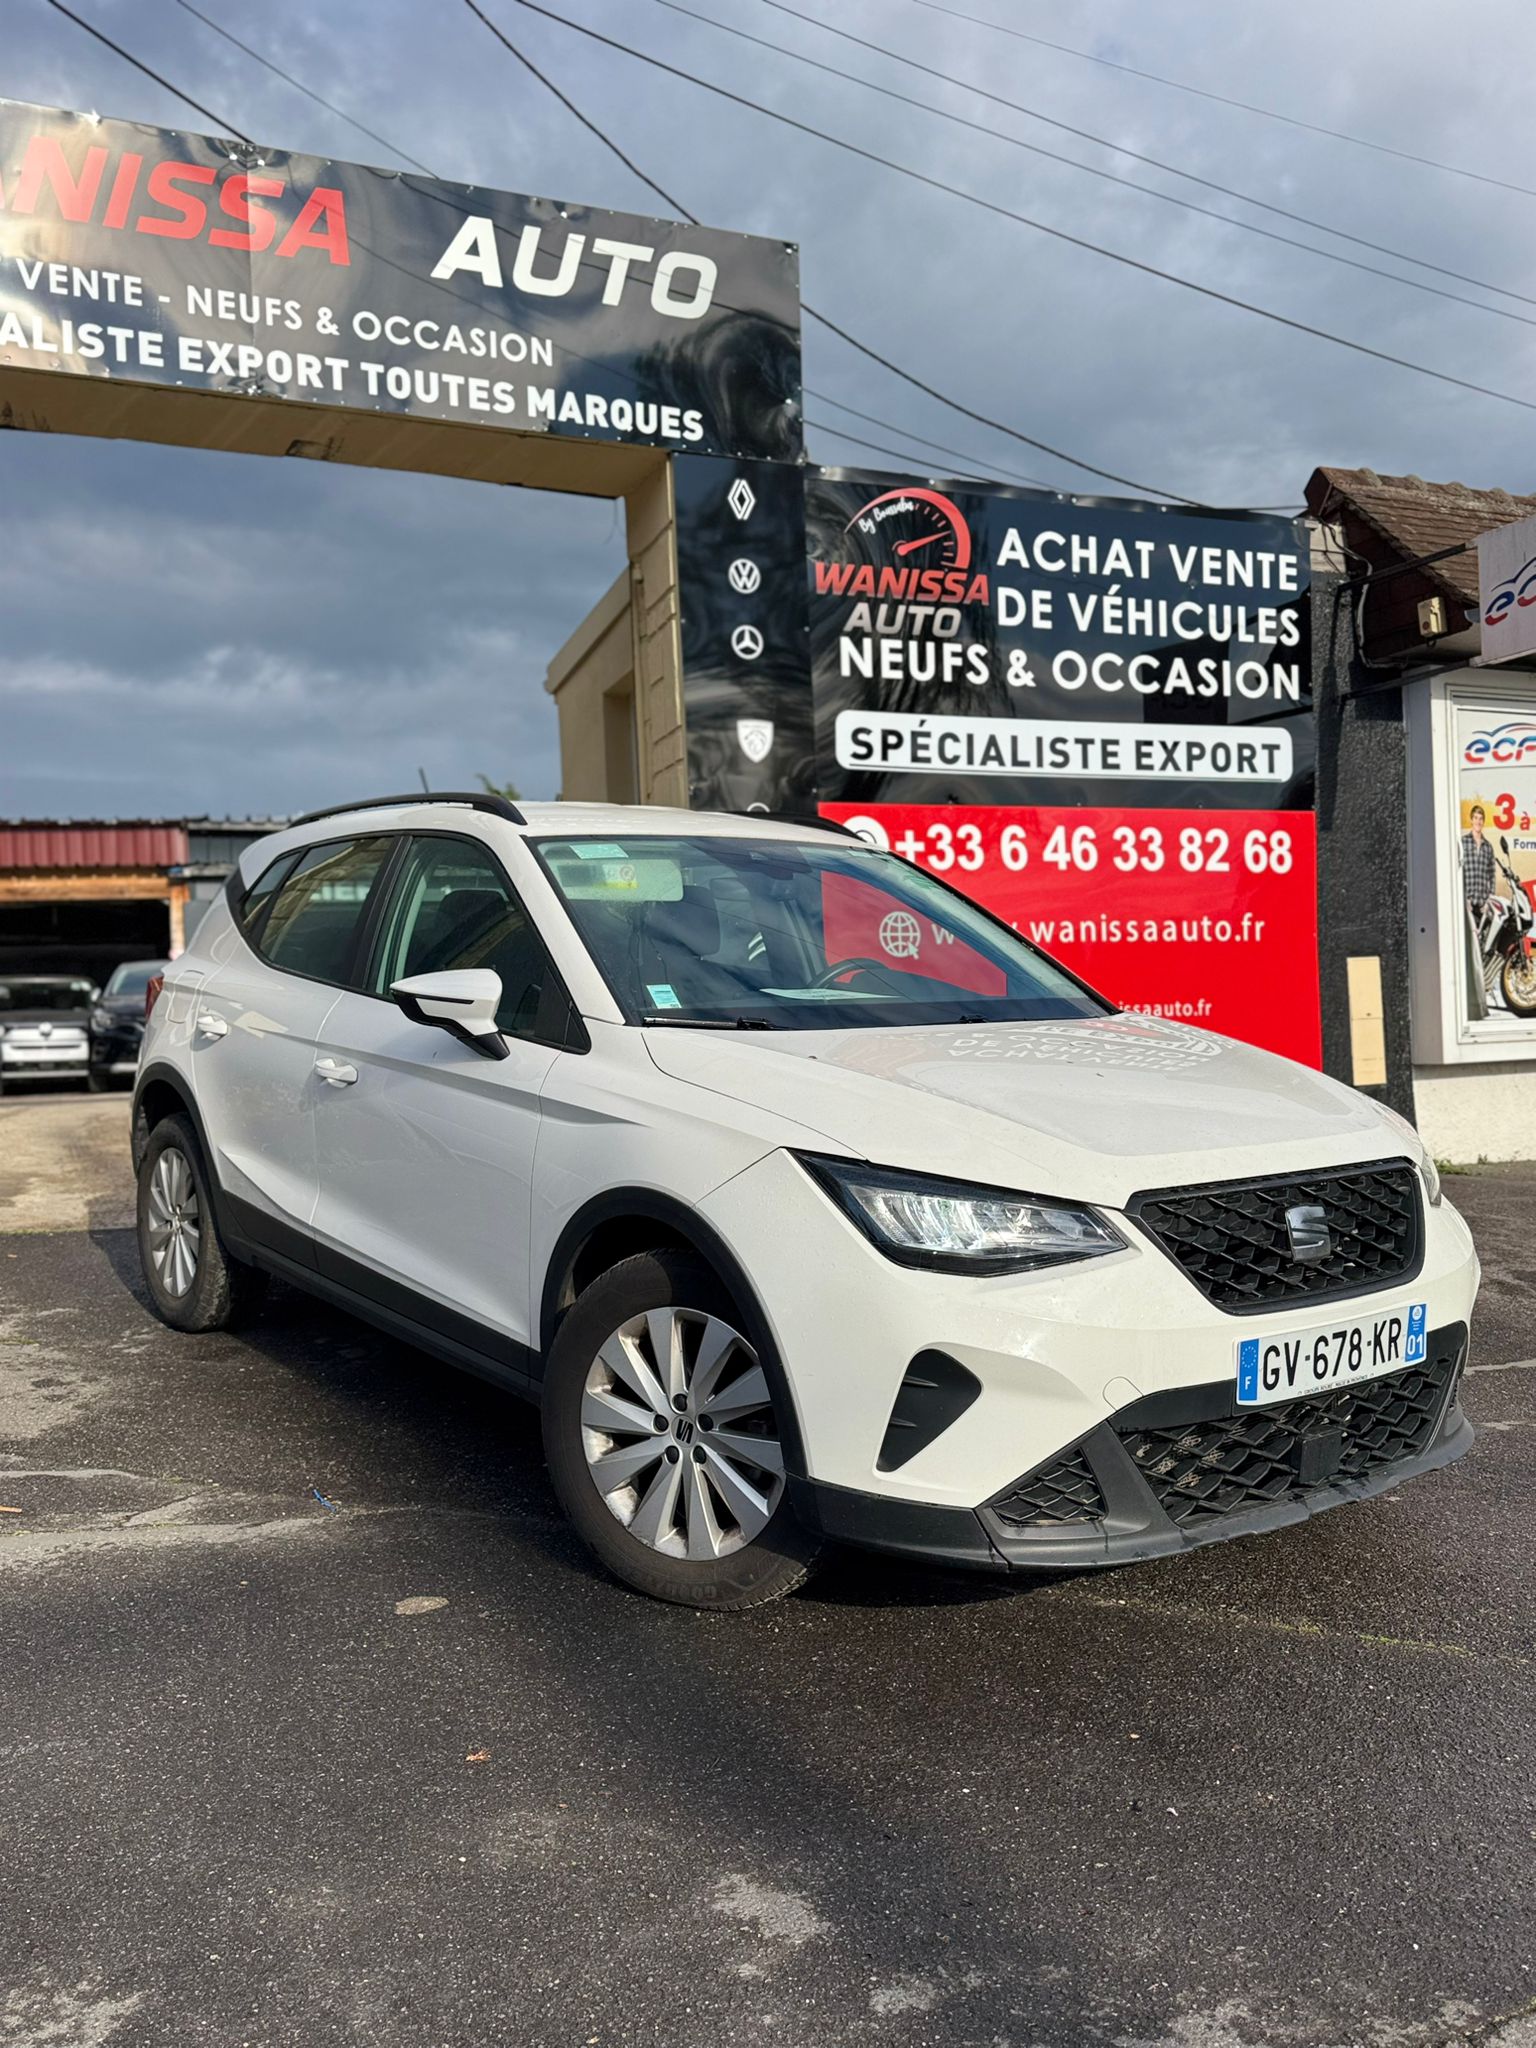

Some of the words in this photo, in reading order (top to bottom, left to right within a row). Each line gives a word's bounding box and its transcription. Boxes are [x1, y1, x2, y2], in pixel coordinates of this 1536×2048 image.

[0, 136, 351, 267] NISSA
[430, 215, 718, 319] AUTO
[16, 258, 143, 308] VENTE
[187, 283, 302, 331] NEUFS
[317, 308, 340, 336] &
[353, 310, 554, 367] OCCASION
[178, 335, 350, 390] EXPORT
[364, 361, 516, 415] TOUTES
[527, 387, 704, 442] MARQUES
[813, 561, 990, 606] WANISSA
[997, 527, 1156, 579] ACHAT
[1168, 544, 1298, 592] VENTE
[842, 602, 962, 638] AUTO
[997, 587, 1053, 630] DE
[1068, 584, 1300, 647] VÉHICULES
[839, 637, 989, 685] NEUFS
[1007, 649, 1037, 688] &
[1052, 650, 1300, 700] OCCASION
[850, 719, 1121, 772] SPÉCIALISTE
[1134, 740, 1281, 774] EXPORT
[1492, 793, 1516, 830] 3
[1519, 811, 1531, 831] à
[895, 823, 985, 871] +33
[1000, 825, 1029, 871] 6
[1043, 826, 1098, 872] 46
[1112, 826, 1165, 872] 33
[1179, 828, 1231, 873] 82
[1243, 830, 1294, 875] 68
[1244, 1376, 1252, 1390] F
[1262, 1317, 1402, 1391] GV-678-KR
[1407, 1333, 1423, 1355] 01
